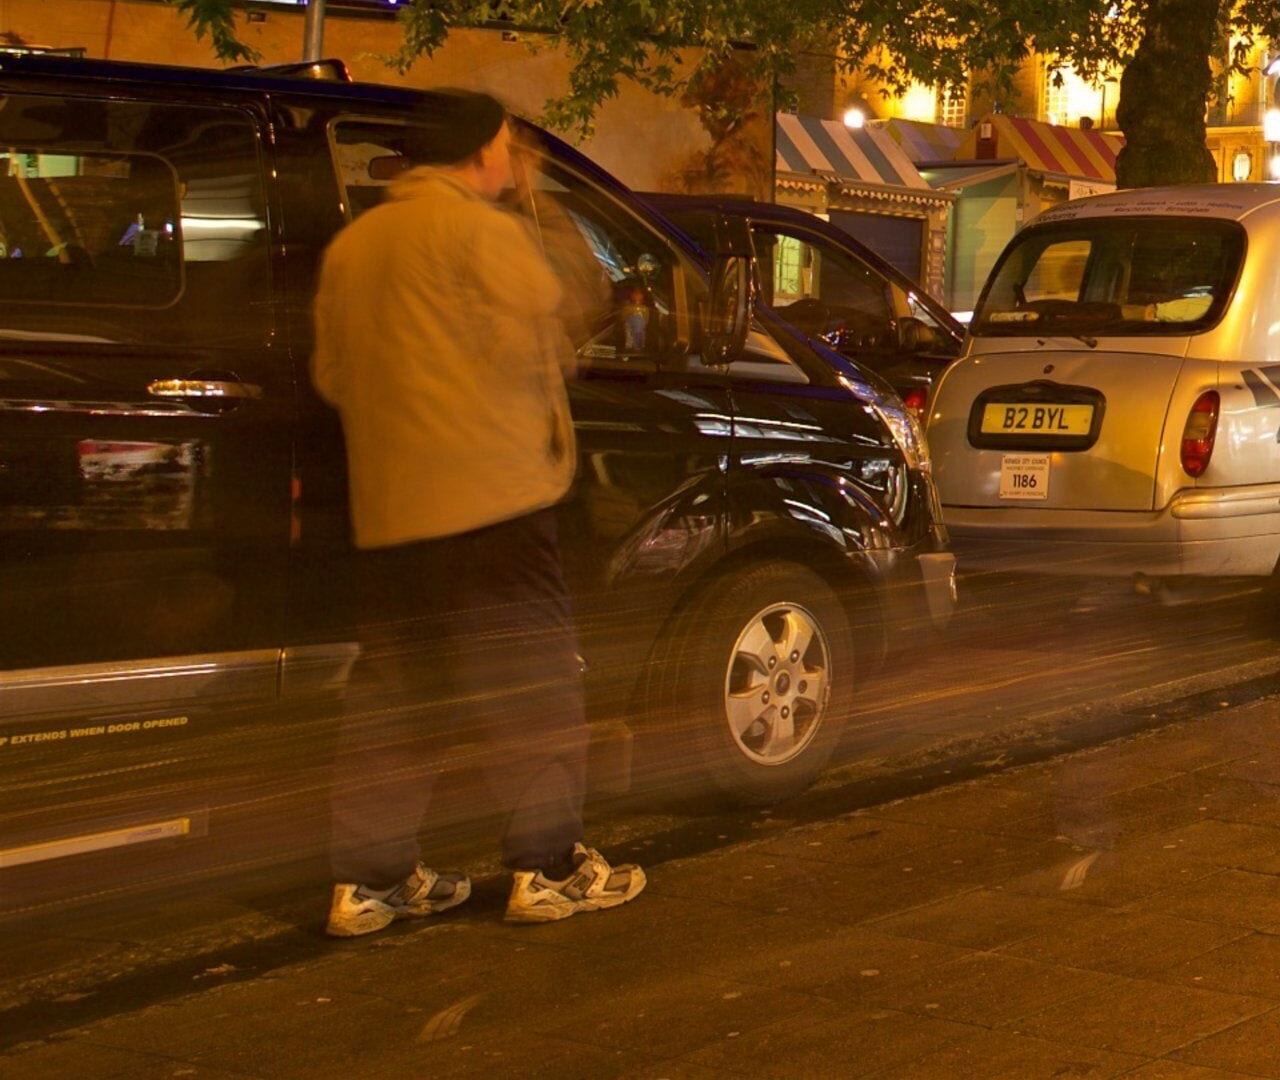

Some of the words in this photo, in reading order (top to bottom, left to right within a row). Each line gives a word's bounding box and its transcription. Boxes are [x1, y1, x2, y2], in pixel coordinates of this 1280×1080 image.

[1002, 407, 1029, 429] B2
[1031, 407, 1070, 430] BYL
[1012, 473, 1038, 488] 1186
[11, 730, 67, 745] EXTENDS
[69, 726, 105, 739] WHEN
[107, 721, 141, 734] DOOR
[142, 716, 189, 729] OPENED
